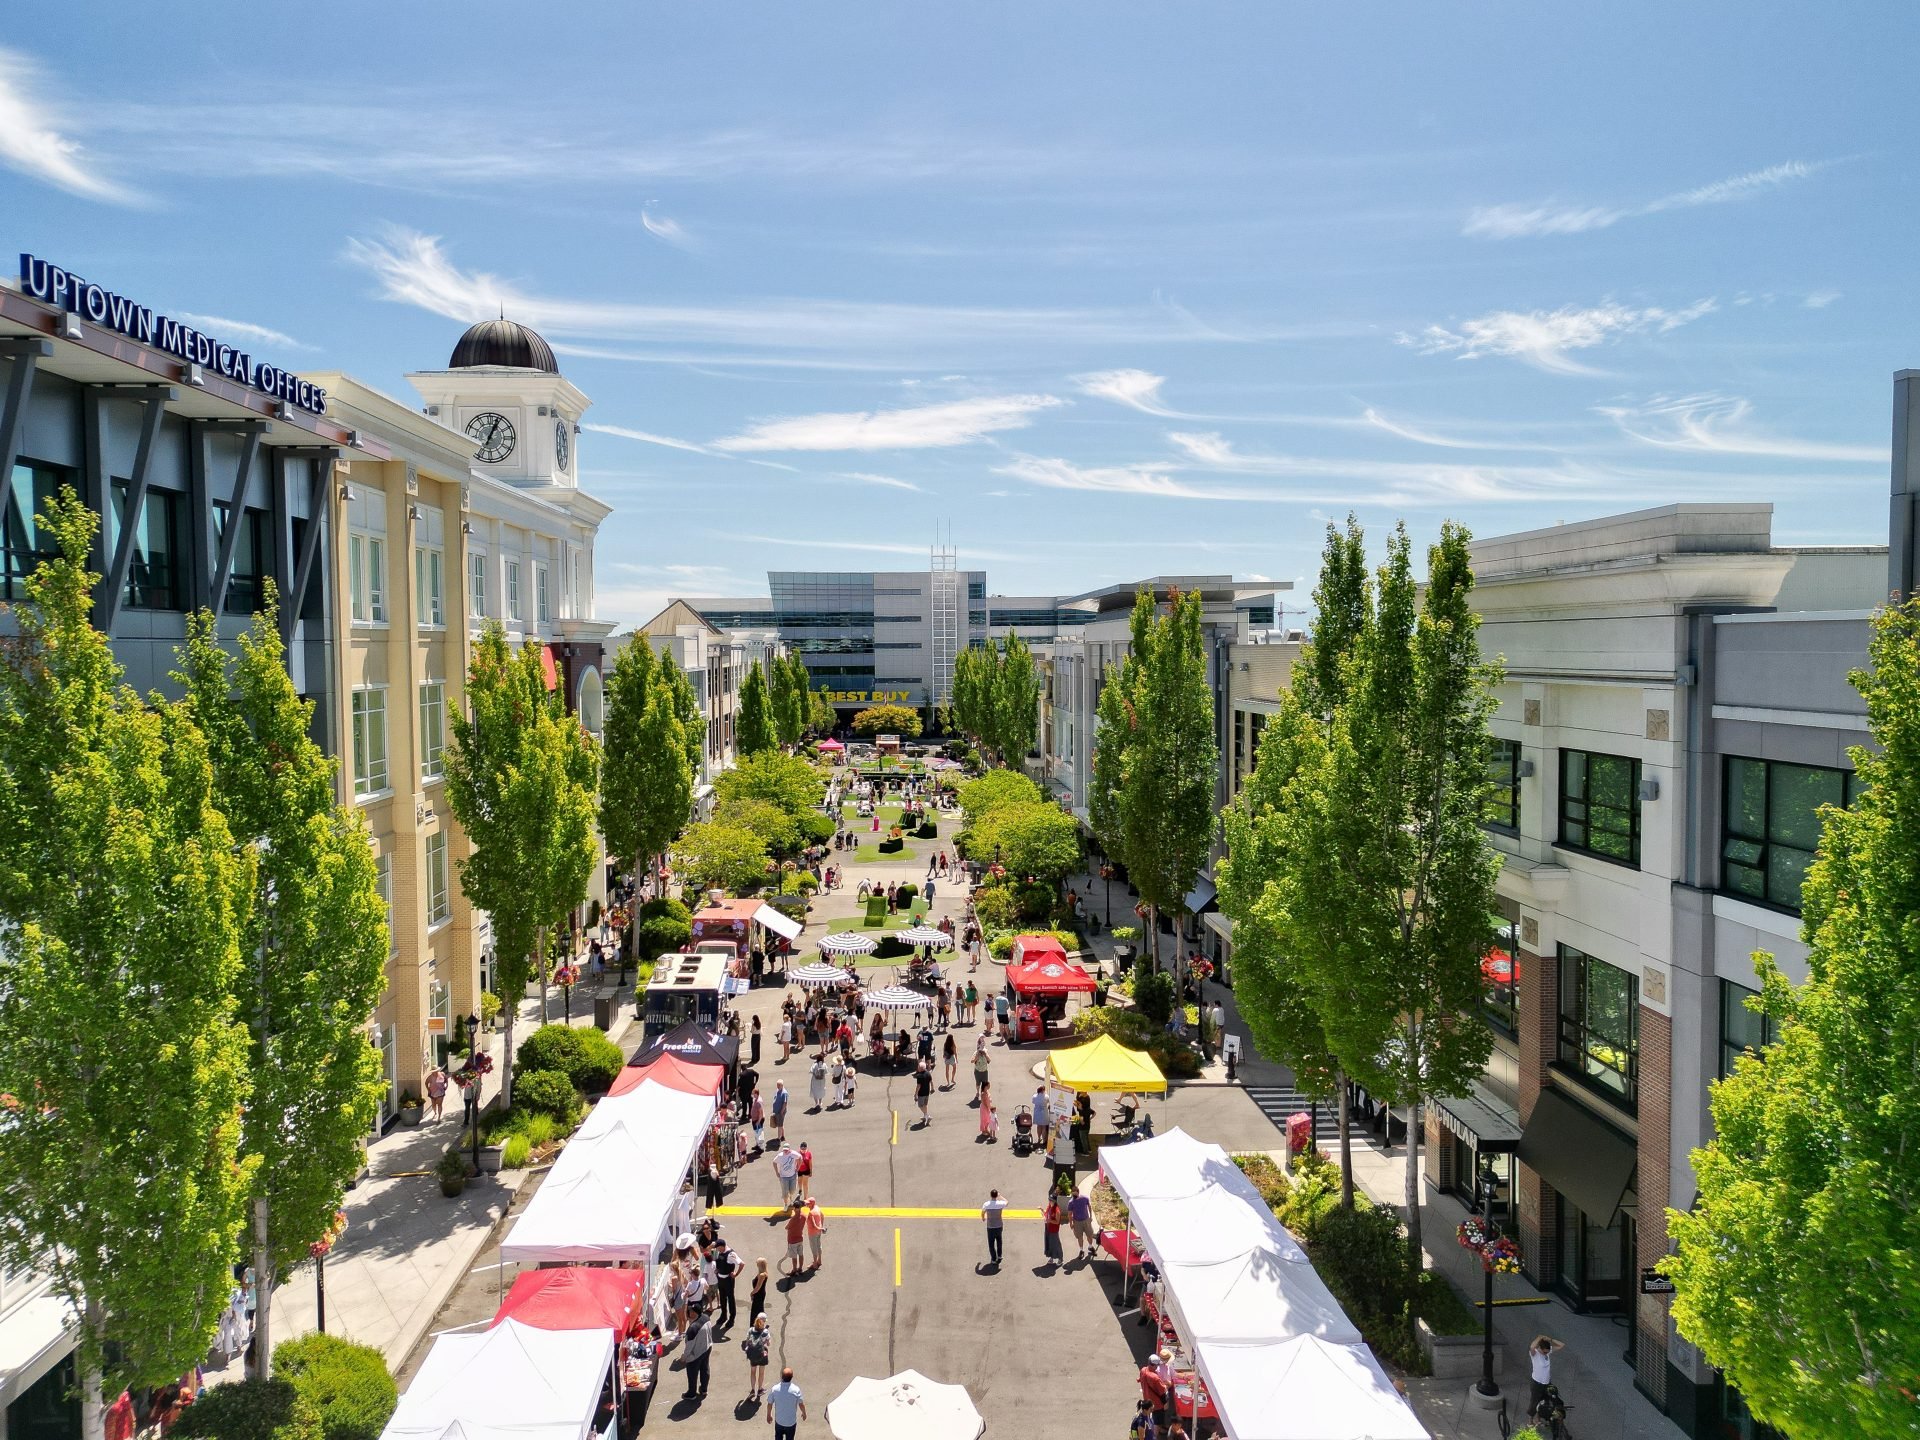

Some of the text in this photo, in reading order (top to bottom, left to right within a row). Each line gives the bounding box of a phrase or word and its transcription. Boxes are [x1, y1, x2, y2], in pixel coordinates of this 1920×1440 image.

[21, 253, 328, 415] UPTOWN MEDICAL OFFICES
[828, 691, 909, 702] BEST BUY
[662, 1043, 702, 1051] Freedom
